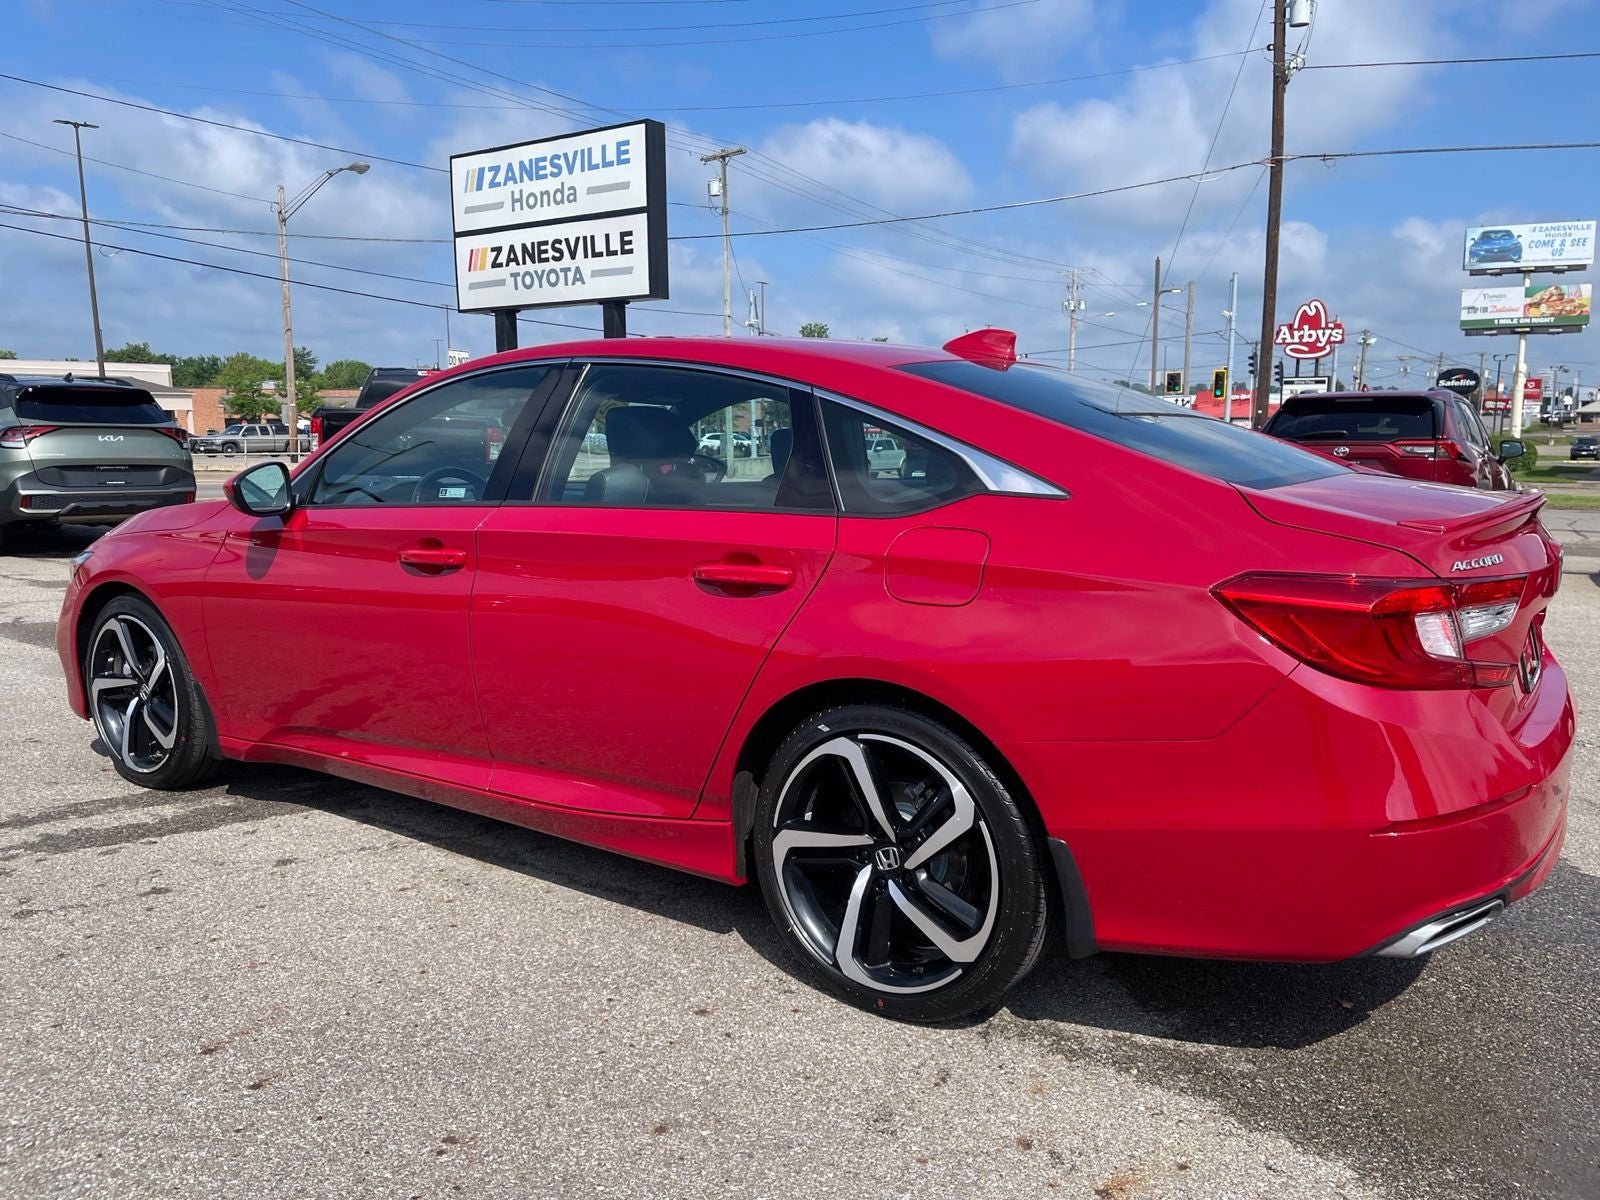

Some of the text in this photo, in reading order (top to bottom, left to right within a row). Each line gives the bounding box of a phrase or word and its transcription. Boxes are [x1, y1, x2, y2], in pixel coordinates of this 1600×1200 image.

[488, 139, 631, 189] ZANESVILLE
[510, 182, 577, 212] Honda
[1537, 223, 1592, 233] ZANESVILLE
[490, 230, 634, 269] ZANESVILLE
[1528, 237, 1589, 249] COME & SEE
[1551, 248, 1564, 257] US
[510, 265, 586, 291] TOYOTA
[1531, 316, 1555, 324] RIGHT
[1275, 322, 1343, 347] Arby's
[448, 355, 457, 366] DO
[1438, 377, 1476, 388] Safelite
[1451, 554, 1504, 572] ACCORD
